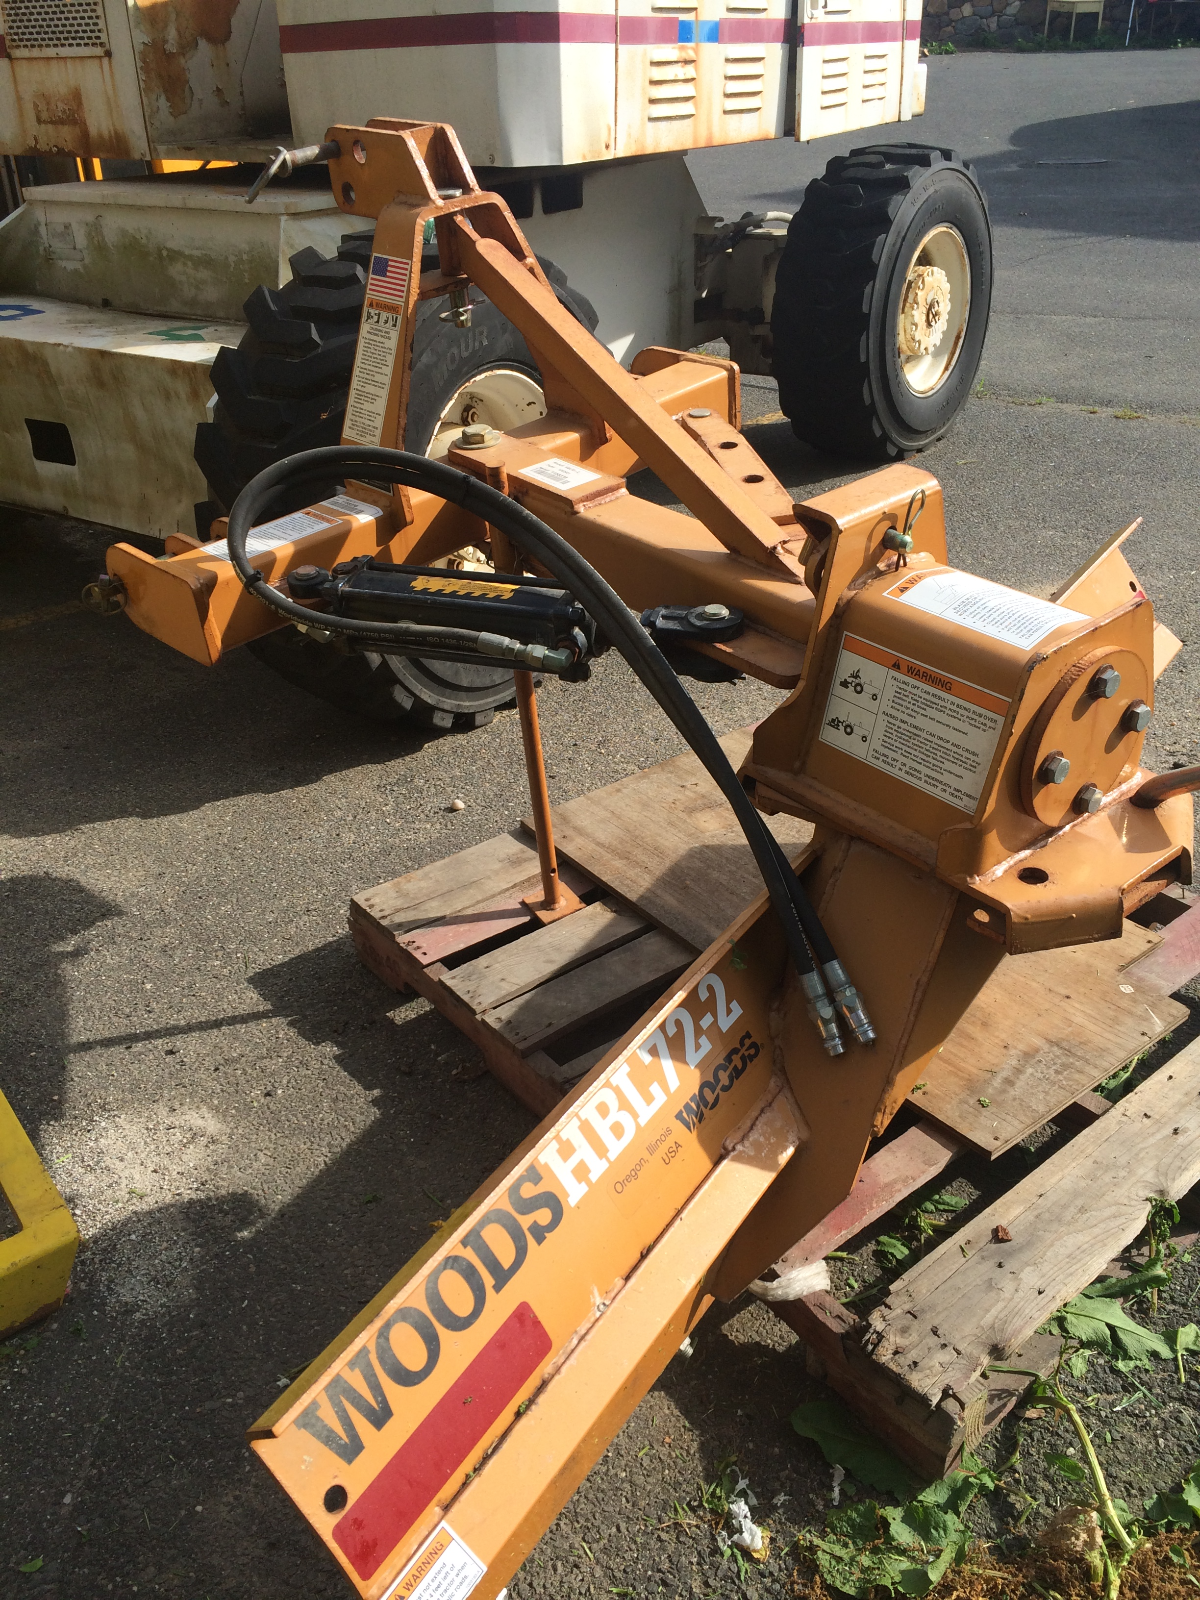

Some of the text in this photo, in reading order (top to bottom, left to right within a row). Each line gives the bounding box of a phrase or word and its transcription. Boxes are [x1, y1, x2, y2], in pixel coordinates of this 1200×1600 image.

[890, 675, 909, 687] FALLING
[910, 683, 919, 691] OFF
[920, 687, 930, 696] CAN
[930, 692, 949, 704] RESULT
[906, 664, 952, 692] WARNING
[881, 710, 898, 721] RAISED
[898, 717, 925, 733] IMPLEMENT
[925, 729, 936, 738] CAN
[936, 734, 950, 745] DROP
[950, 741, 962, 750] AND
[872, 748, 888, 759] FALLING
[613, 1125, 672, 1194] Oregon, Illinois
[662, 1140, 682, 1166] USA
[293, 972, 743, 1465] WOODS HBL72-2
[402, 1541, 444, 1592] WARNING
[422, 1582, 432, 1594] not
[430, 1562, 447, 1583] extend
[432, 1580, 443, 1594] feet
[450, 1563, 456, 1572] of
[440, 1562, 468, 1598] tractor when
[454, 1574, 470, 1592] roads.
